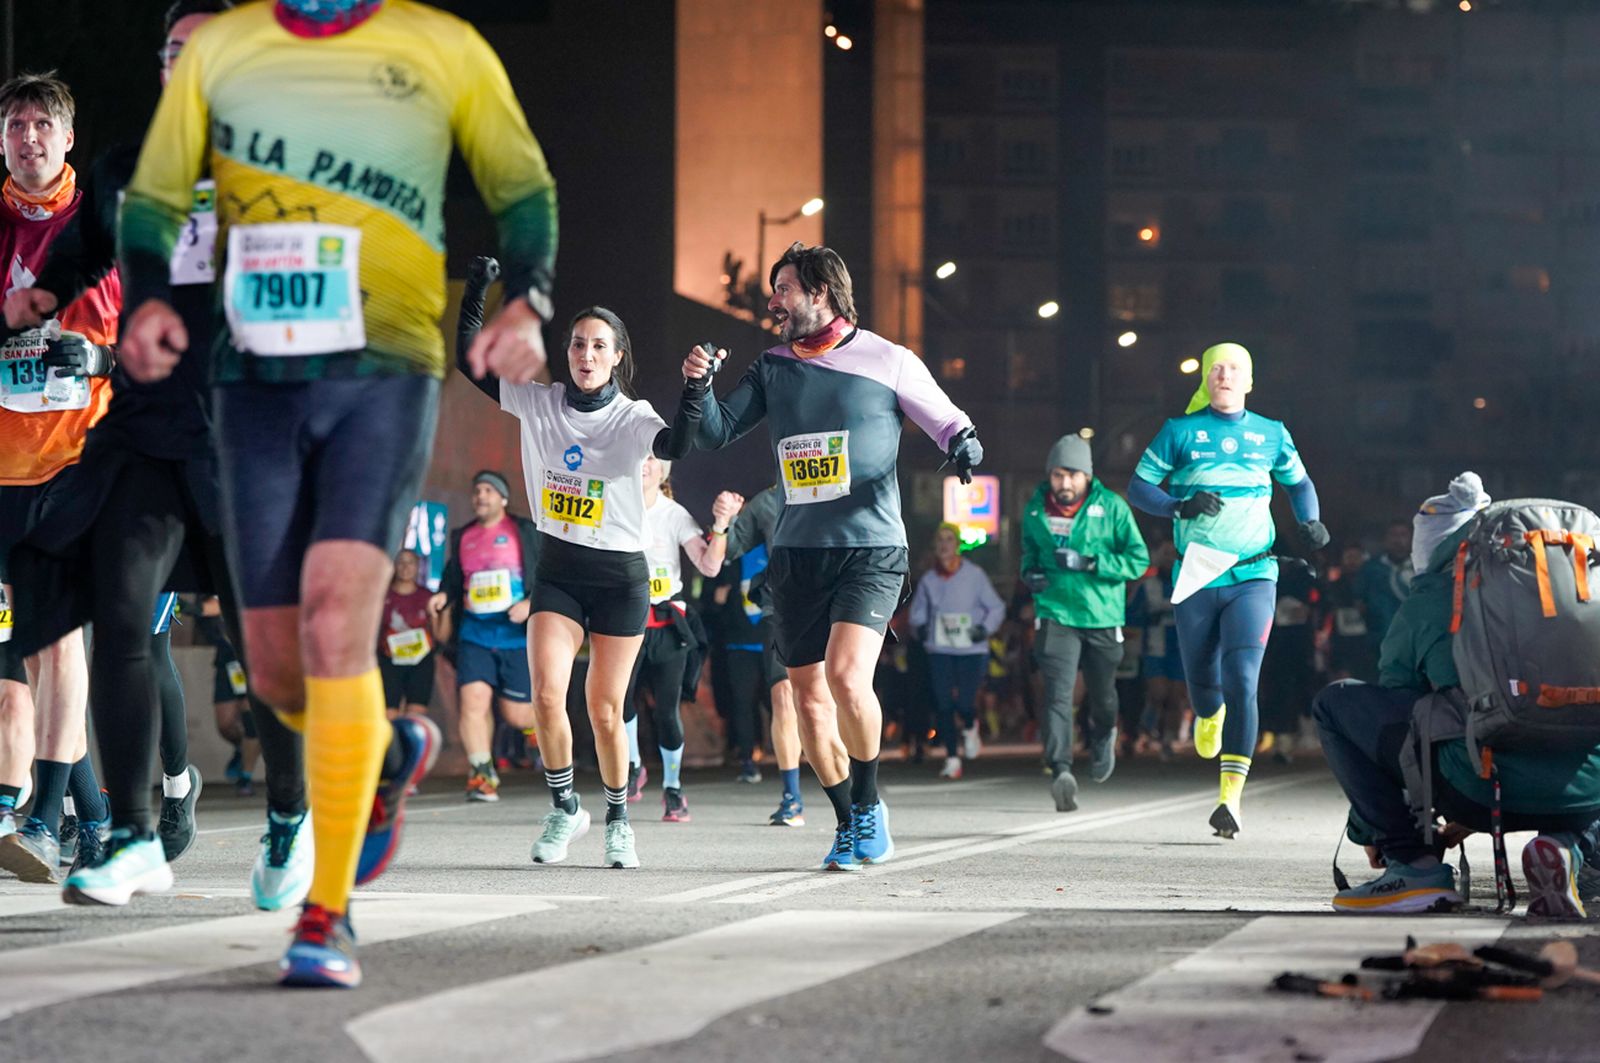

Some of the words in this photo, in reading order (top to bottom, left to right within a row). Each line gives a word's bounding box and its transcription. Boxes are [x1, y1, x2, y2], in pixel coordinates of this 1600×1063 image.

[248, 131, 286, 170] LA
[249, 271, 326, 309] 7907
[4, 349, 22, 360] SAN
[14, 338, 43, 348] NOCHE
[8, 359, 48, 386] 139
[789, 455, 839, 480] 13657
[546, 482, 558, 490] SAN
[553, 474, 573, 484] NOCHE
[573, 479, 582, 487] DE
[549, 491, 595, 519] 13112
